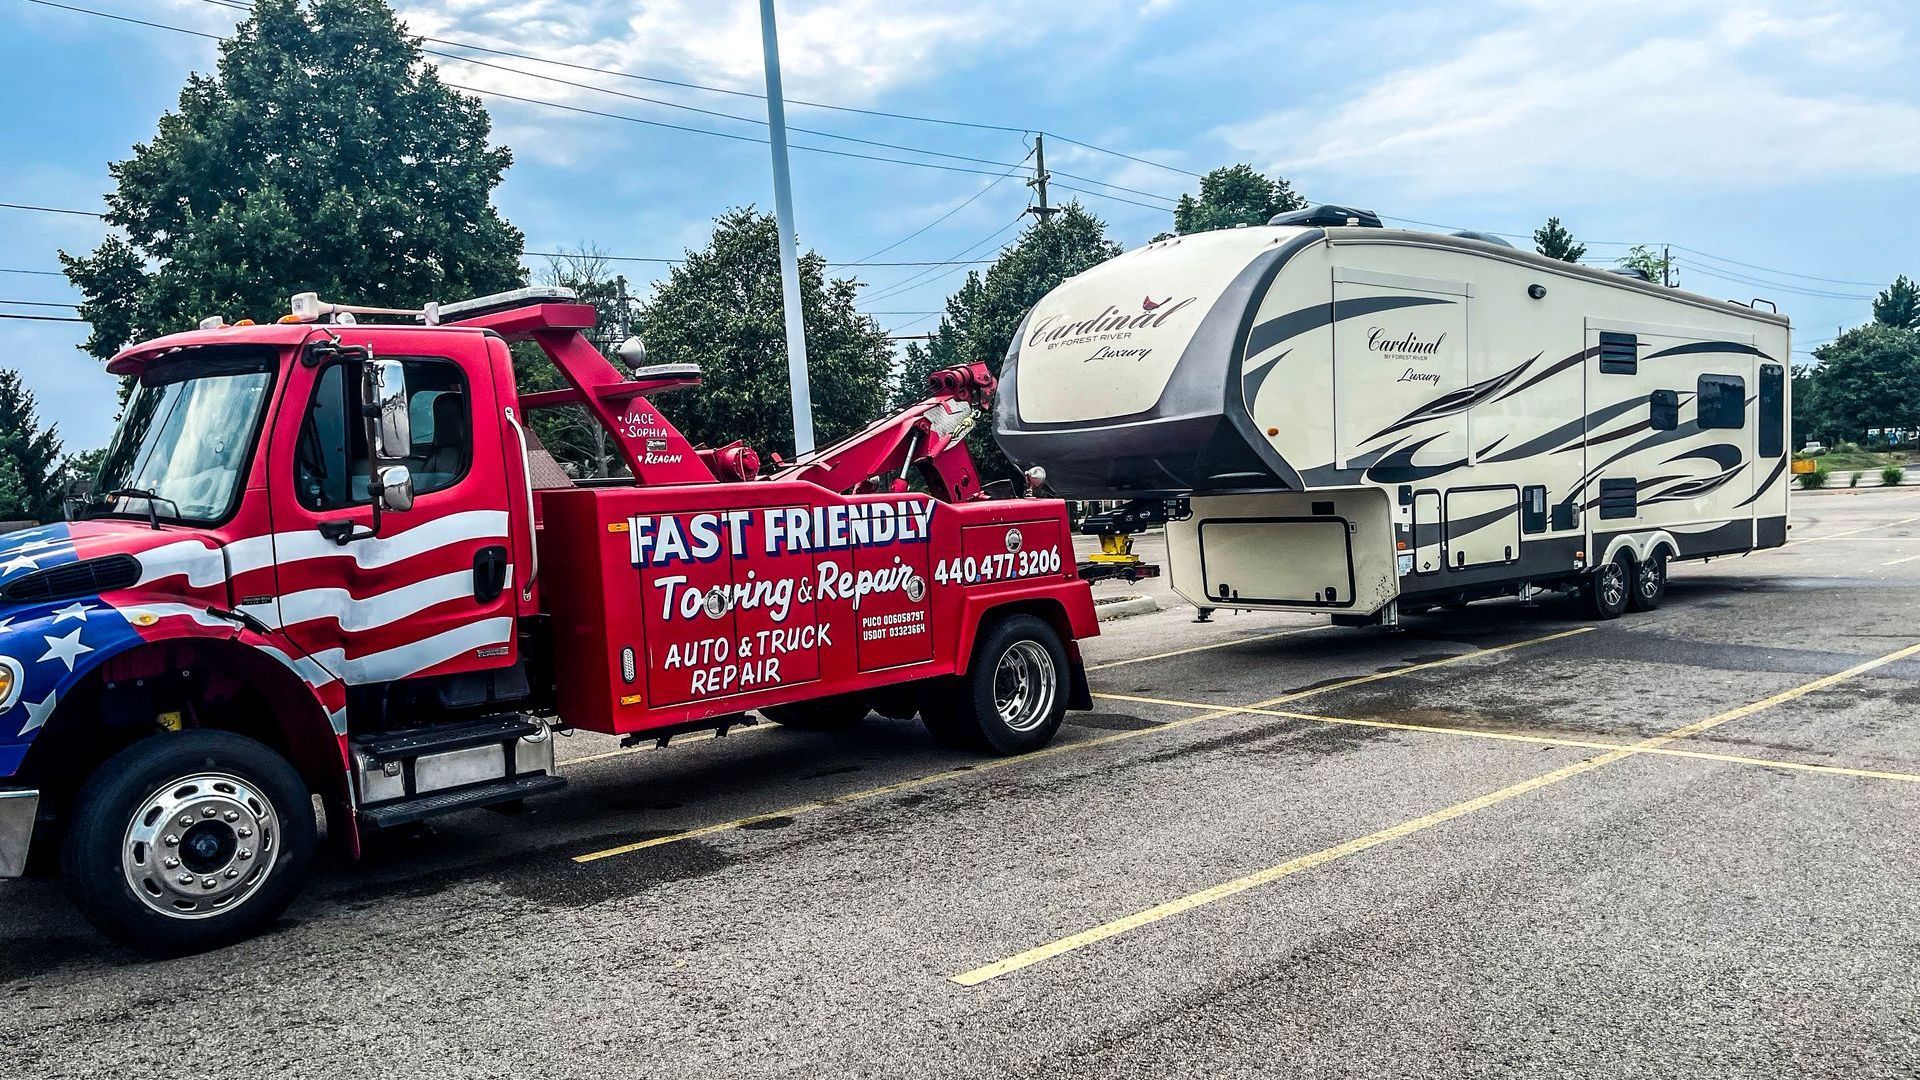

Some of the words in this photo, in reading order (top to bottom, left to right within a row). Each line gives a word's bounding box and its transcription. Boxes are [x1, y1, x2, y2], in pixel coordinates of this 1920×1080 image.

[1028, 296, 1197, 348] Cardinal
[1048, 341, 1060, 350] BY
[1060, 334, 1098, 347] FOREST
[1100, 331, 1132, 341] RIVER
[1367, 326, 1447, 354] Cardinal
[1084, 345, 1153, 363] Luxury
[1396, 367, 1441, 387] Luxury
[624, 412, 655, 425] JACE
[627, 425, 668, 438] SOPHIA
[644, 452, 682, 465] REAGAN
[627, 510, 752, 566] FAST
[763, 499, 936, 555] FRIENDLY
[934, 544, 1061, 585] 440.477.3206
[654, 570, 794, 622] Towing
[797, 577, 813, 603] &
[817, 555, 914, 611] Repair
[862, 616, 882, 628] PUCO
[883, 610, 925, 625] 00605879T
[863, 629, 887, 641] USDOT
[889, 623, 926, 637] 03323664
[664, 637, 729, 670] AUTO
[738, 636, 752, 658] &
[756, 622, 832, 656] TRUCK
[690, 657, 781, 695] REPAIR
